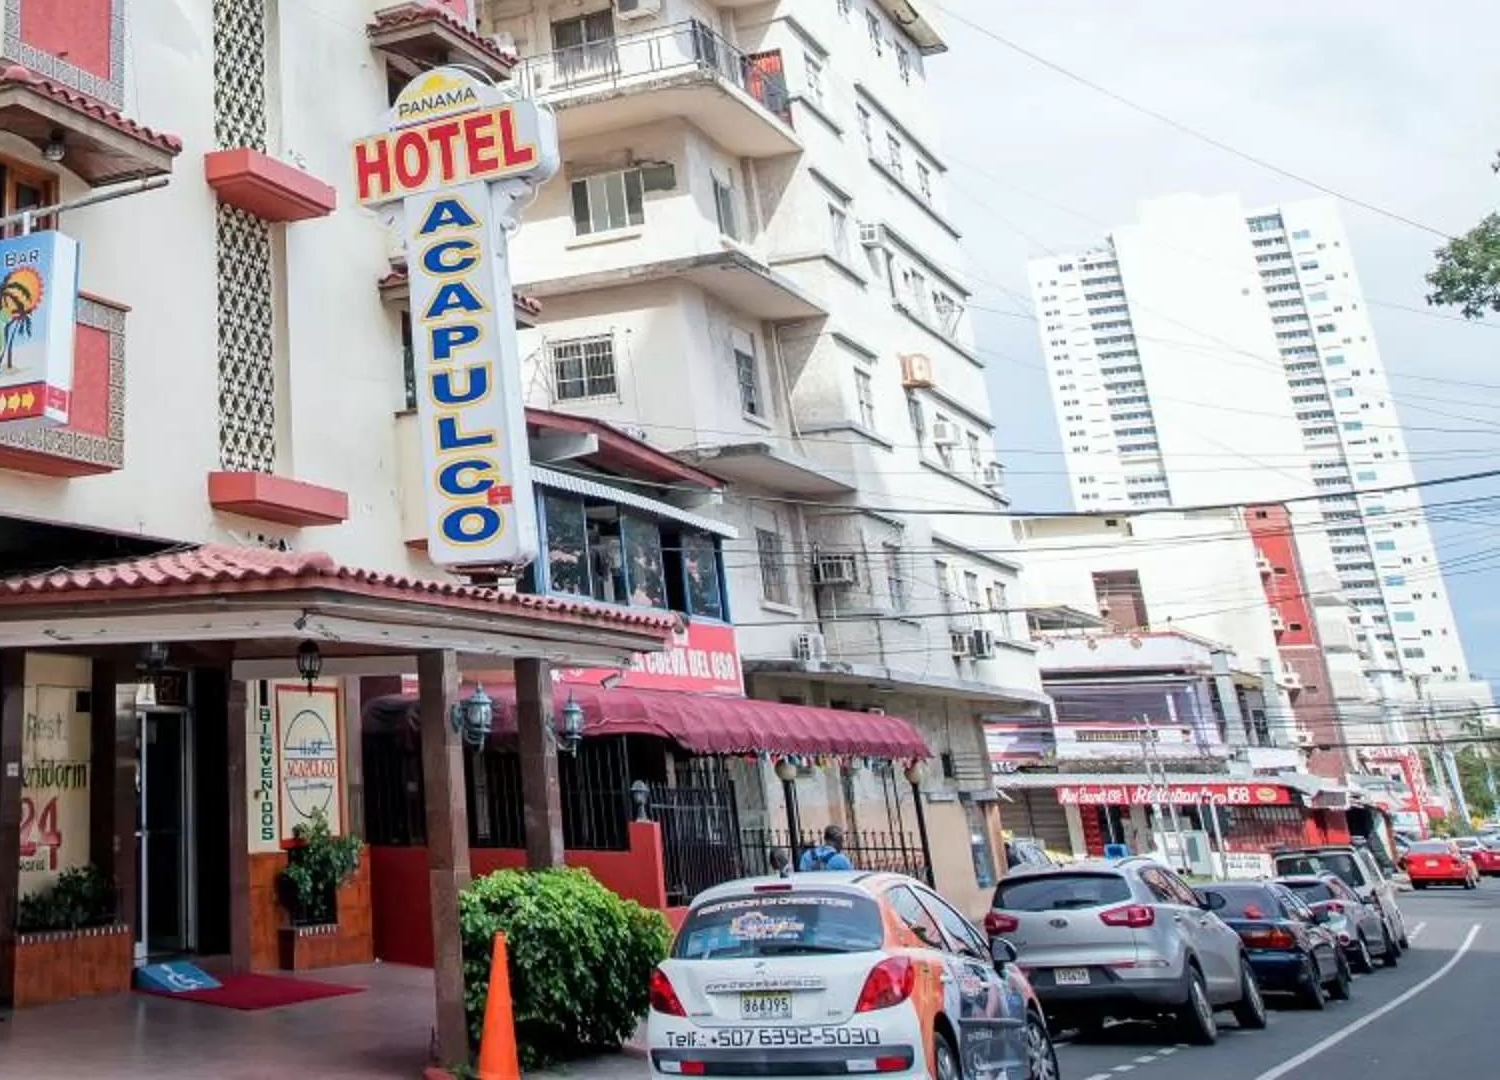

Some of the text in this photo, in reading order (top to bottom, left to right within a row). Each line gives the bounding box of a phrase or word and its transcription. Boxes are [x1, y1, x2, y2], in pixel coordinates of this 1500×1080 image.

[399, 87, 477, 117] PANAMA
[355, 108, 533, 200] HOTEL
[419, 199, 501, 543] ACAPULCO
[648, 647, 687, 677] CUEVA
[689, 649, 711, 678] DEL
[712, 651, 736, 680] OSO
[259, 708, 275, 841] BIENVENIDOS
[20, 796, 62, 870] 24
[759, 1027, 881, 1045] 6392-5030
